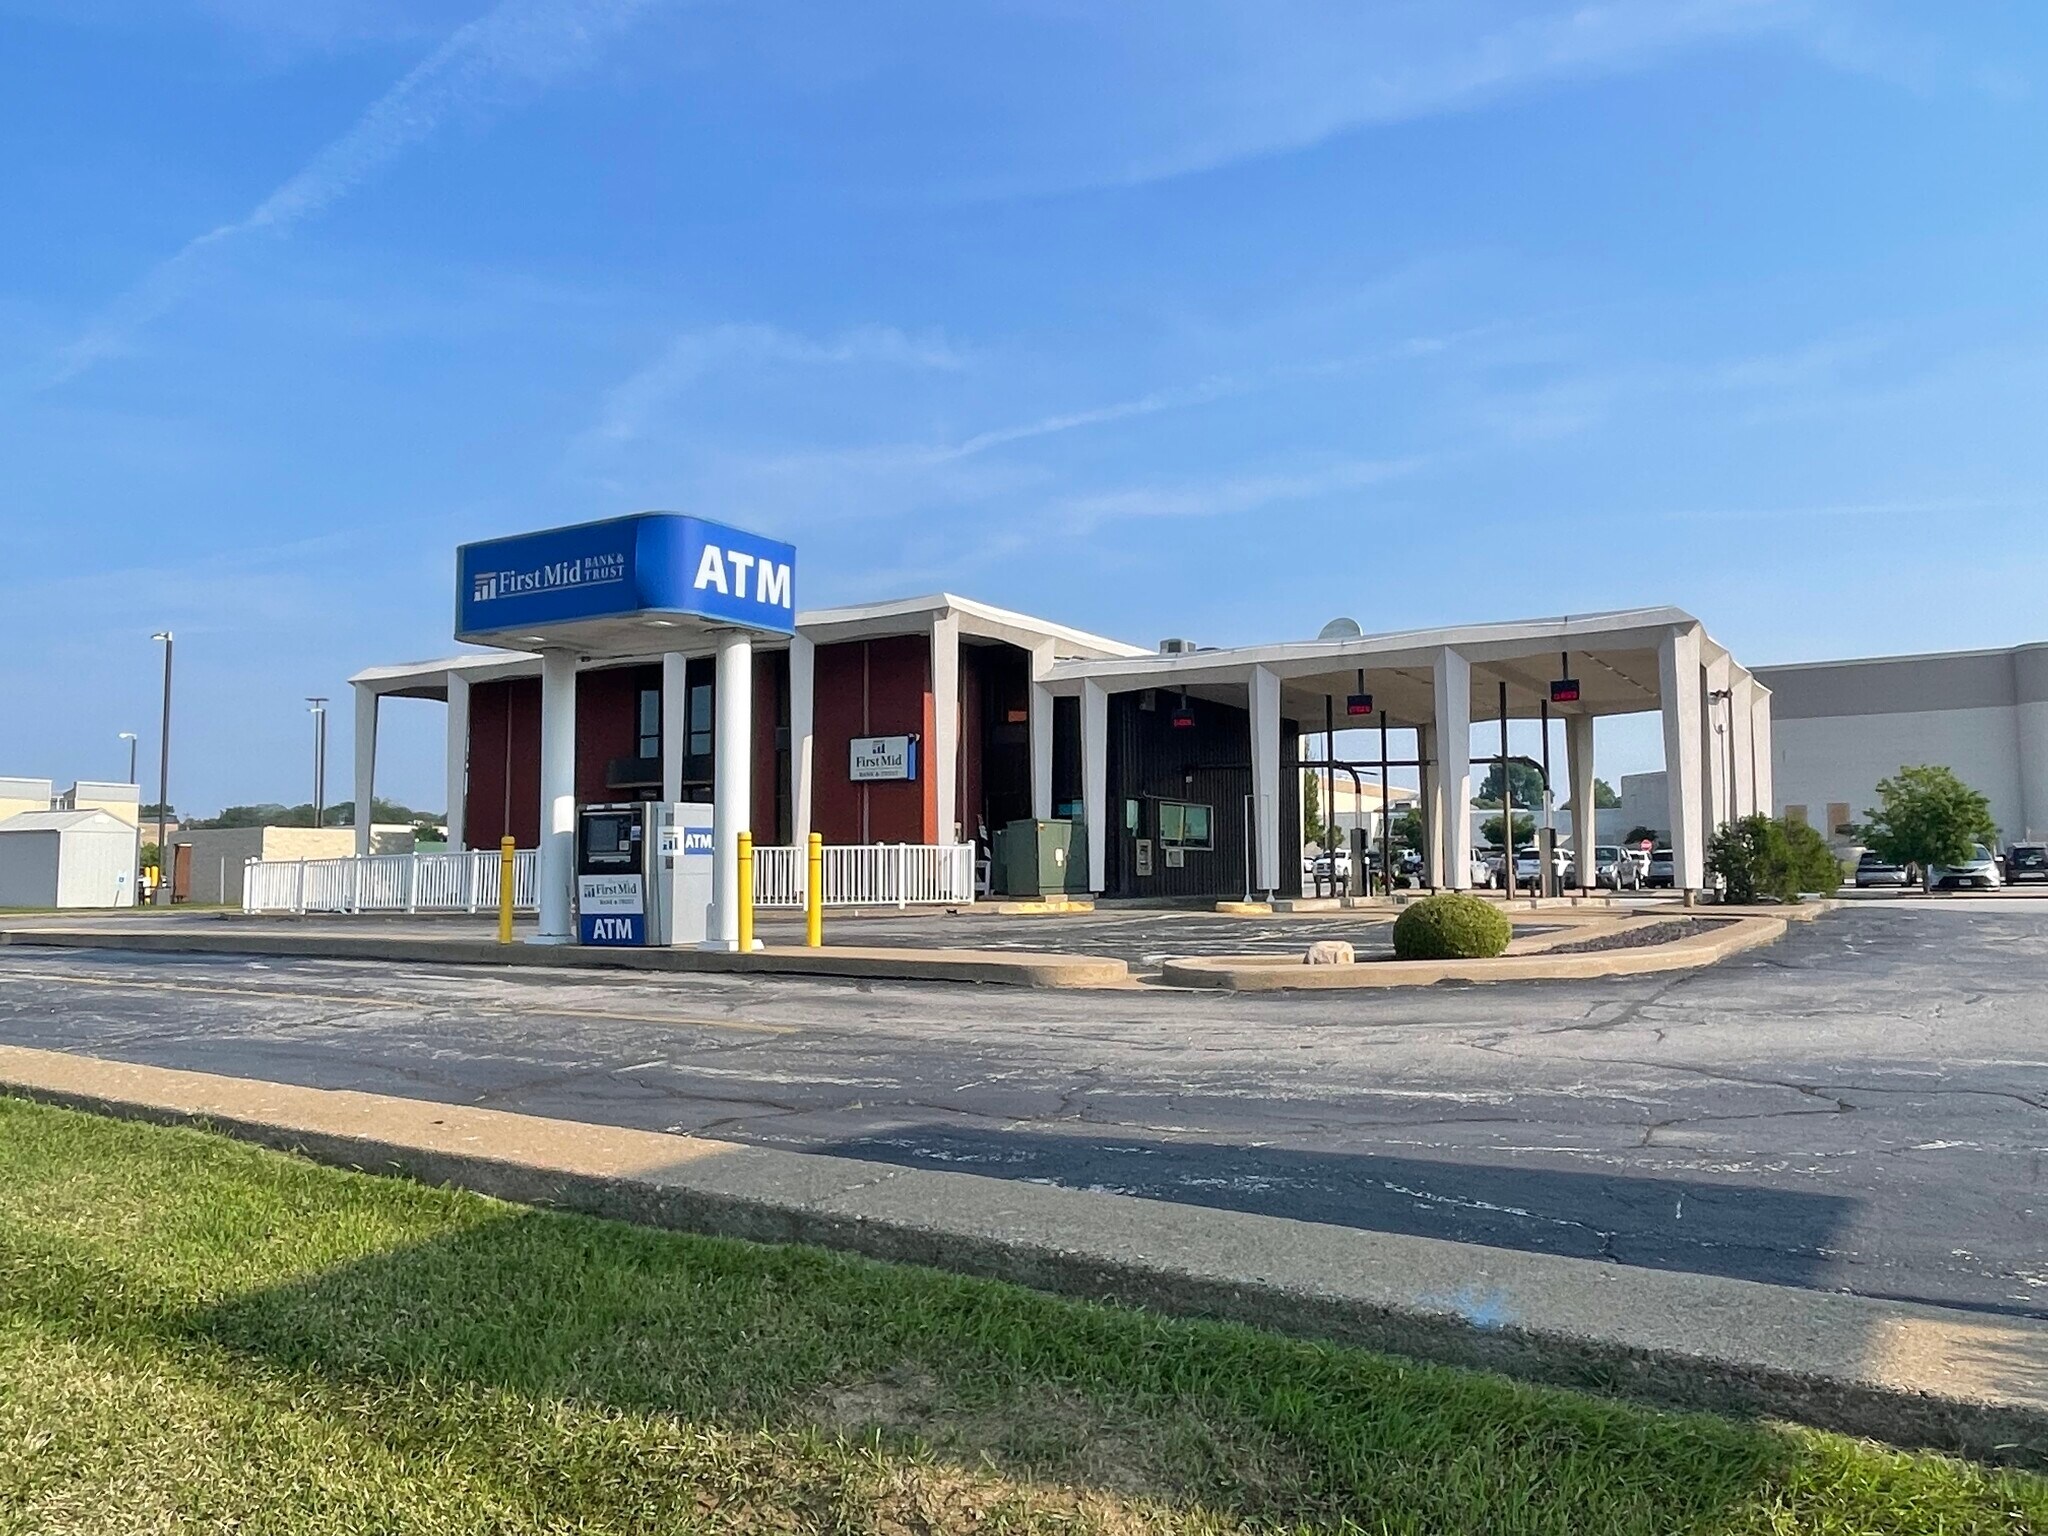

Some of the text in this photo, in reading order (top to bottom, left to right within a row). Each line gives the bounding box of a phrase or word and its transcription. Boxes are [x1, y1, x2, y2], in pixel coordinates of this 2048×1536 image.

[584, 552, 625, 569] BANK &
[499, 559, 582, 594] First Mid
[584, 564, 625, 581] TRUST
[693, 544, 791, 609] ATM
[857, 754, 901, 767] First Mid
[685, 834, 712, 849] ATM
[596, 882, 637, 895] First Mid
[593, 919, 632, 940] ATM
